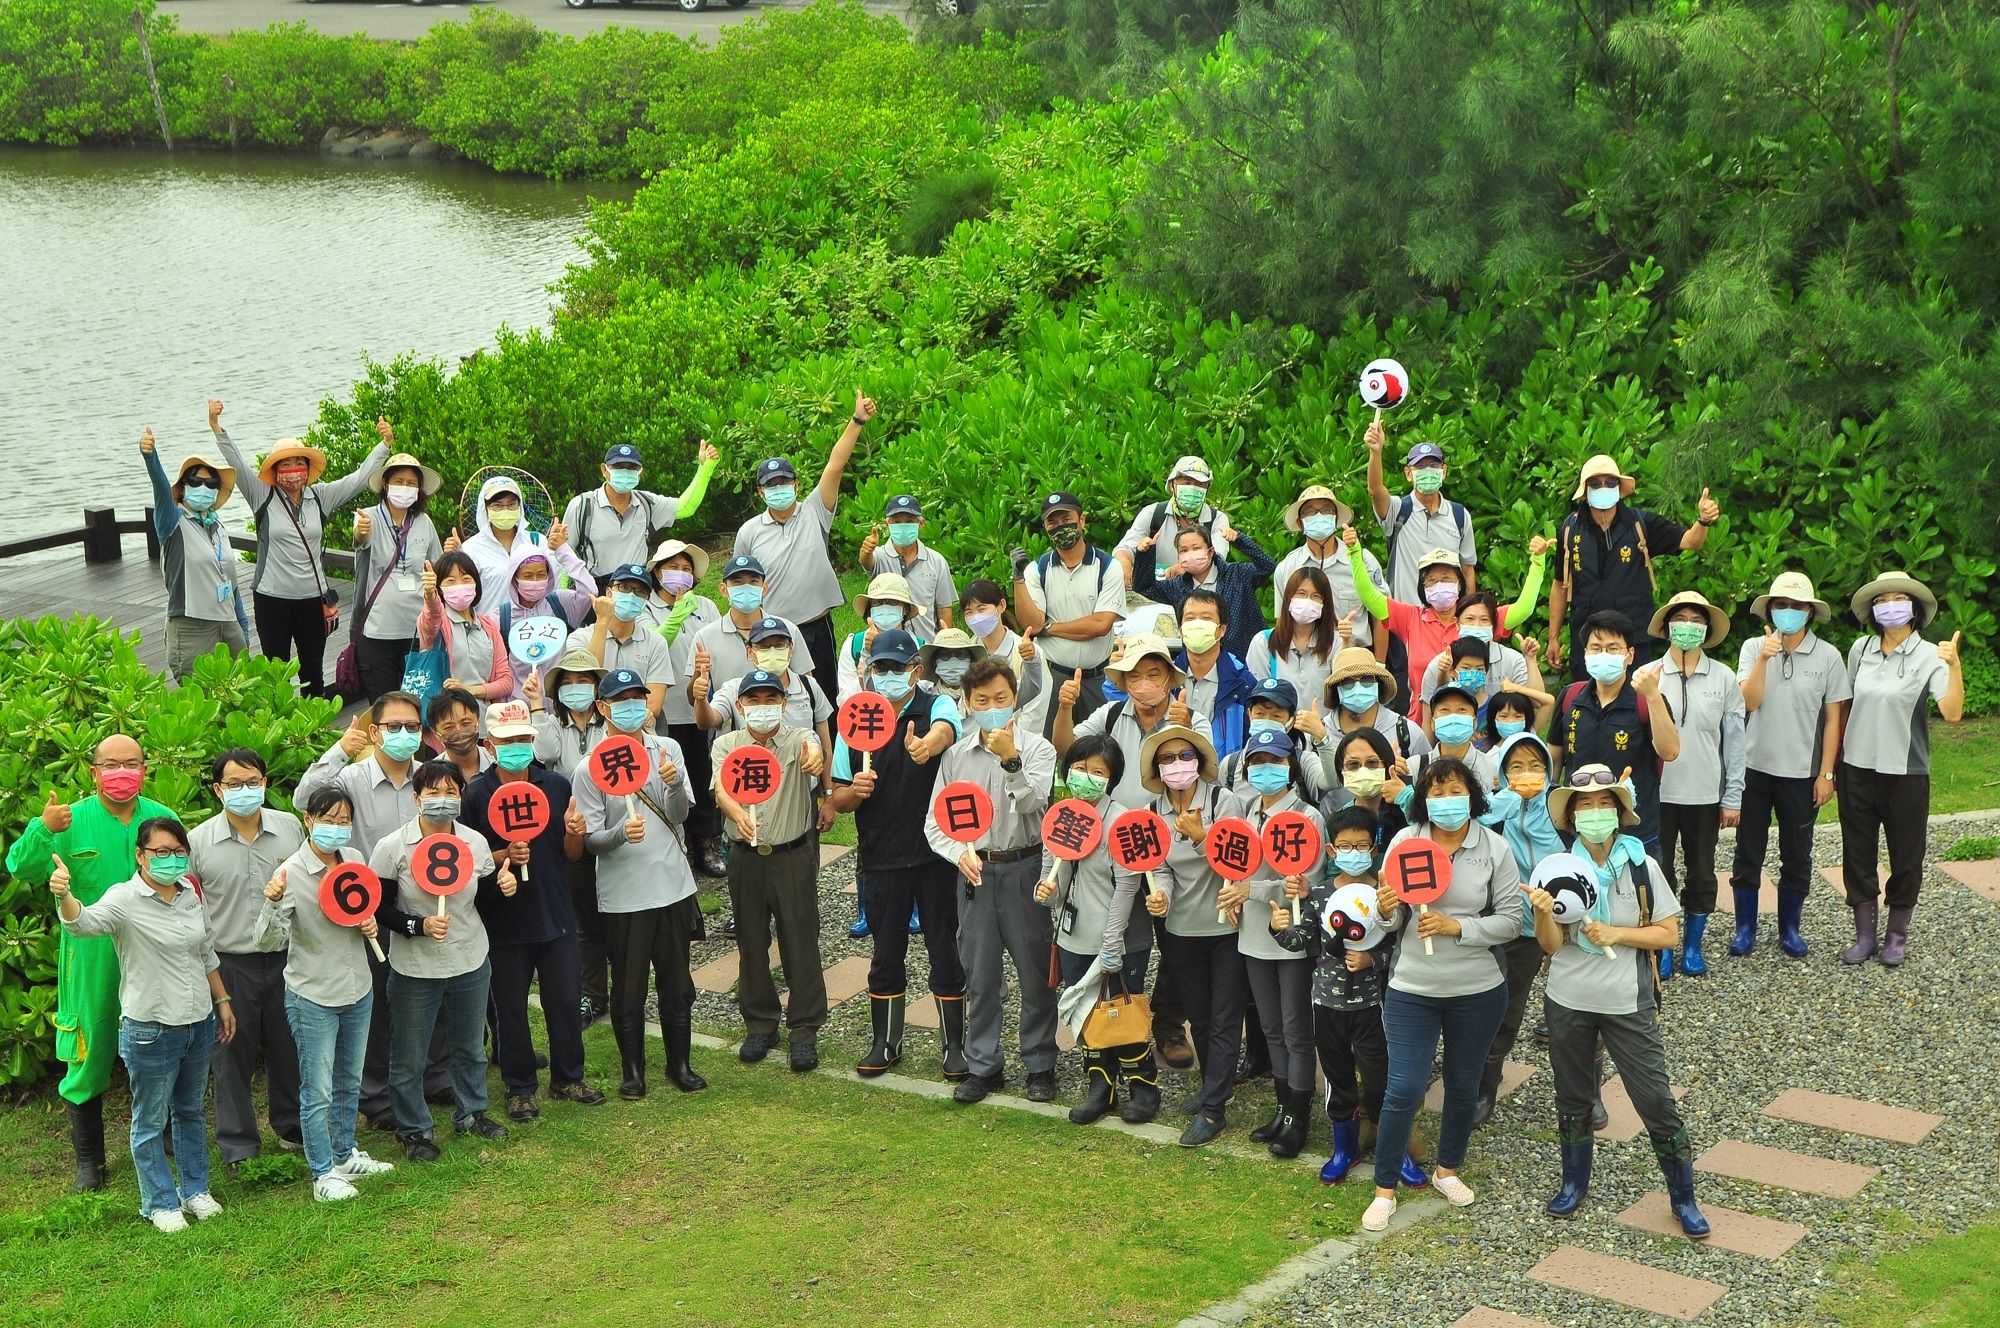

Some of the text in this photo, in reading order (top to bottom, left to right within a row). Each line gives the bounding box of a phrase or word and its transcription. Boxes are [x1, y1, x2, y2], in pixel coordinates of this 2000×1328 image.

[518, 621, 559, 640] 台江
[847, 702, 885, 740] 洋
[600, 744, 640, 788] 界
[732, 757, 772, 794] 海
[498, 793, 540, 833] 世
[945, 793, 981, 833] 日
[1047, 805, 1096, 853] 蟹
[1116, 818, 1162, 864] 謝
[1213, 827, 1250, 874] 過
[1269, 822, 1308, 863] 好
[426, 841, 459, 886] 8
[1398, 850, 1438, 893] 日
[333, 871, 370, 915] 6
